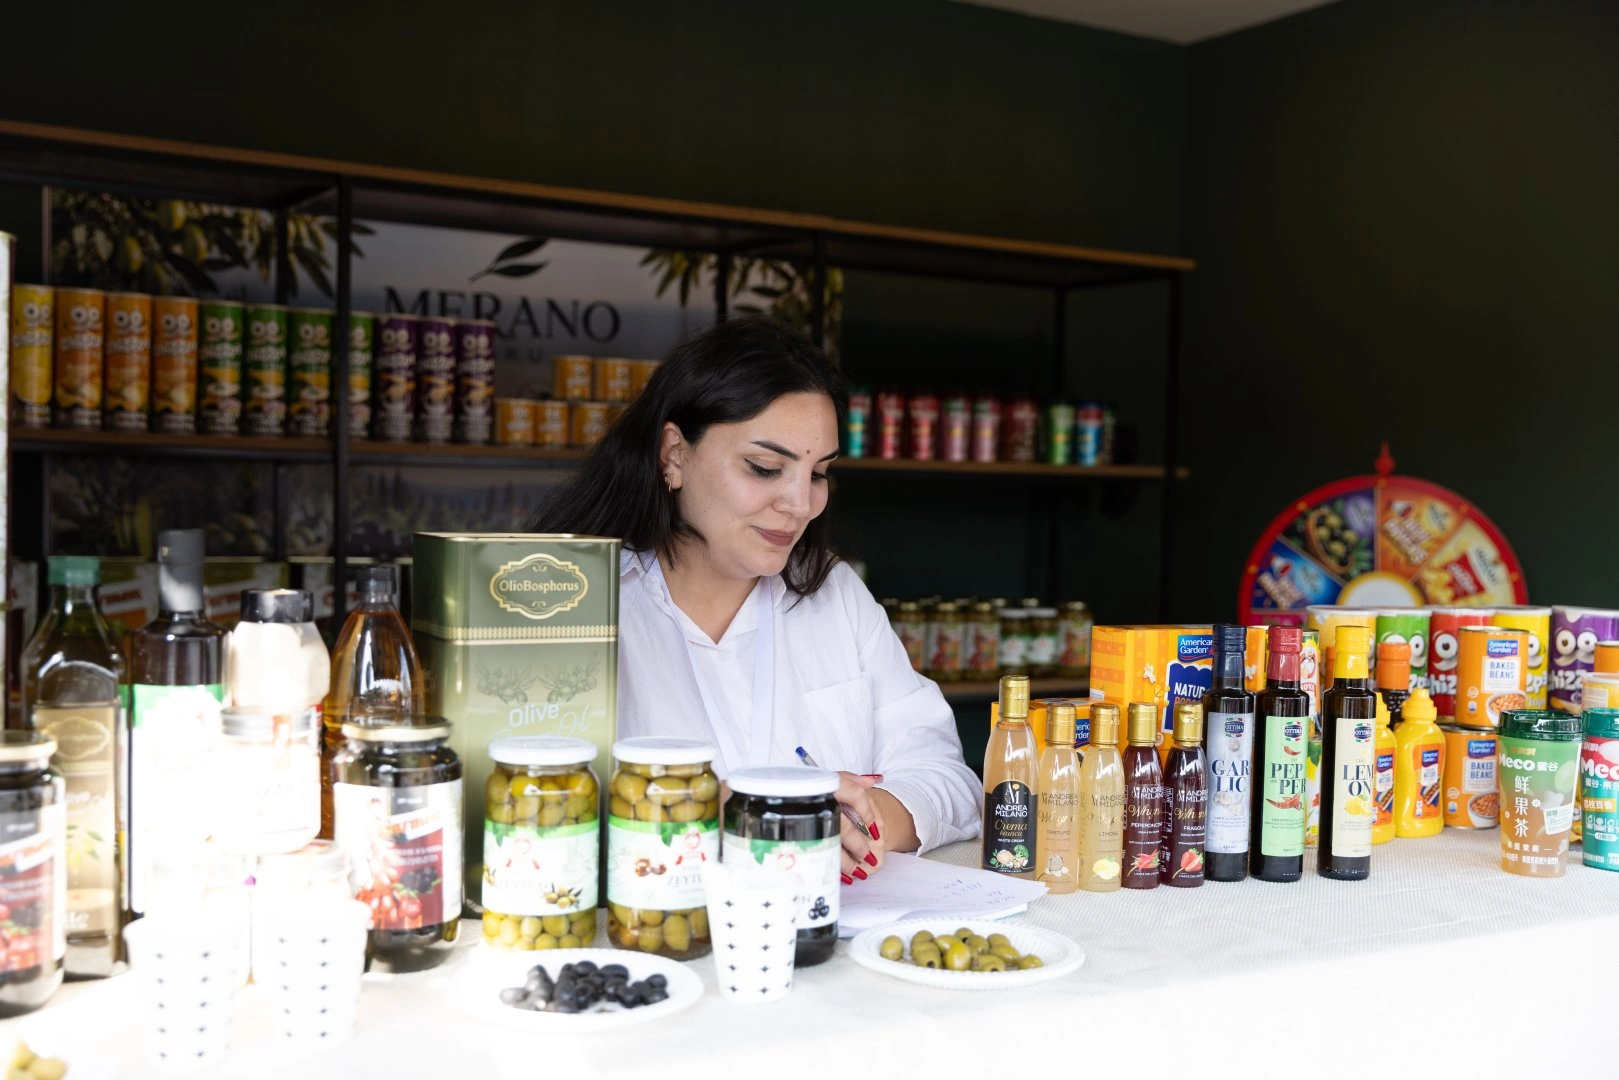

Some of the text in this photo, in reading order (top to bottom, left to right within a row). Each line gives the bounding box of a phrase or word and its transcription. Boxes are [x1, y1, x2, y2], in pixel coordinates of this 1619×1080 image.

[383, 285, 621, 345] MERANO
[499, 580, 581, 597] OlioBosphorus
[1180, 646, 1207, 655] Garden
[1490, 660, 1516, 670] BAKED
[1489, 669, 1515, 679] BEANS
[509, 704, 560, 728] Olive
[1211, 759, 1249, 777] GAR
[1271, 763, 1303, 780] PEP
[1470, 761, 1494, 771] BAKED
[1470, 770, 1493, 780] BEANS
[1216, 776, 1247, 793] LIC
[1279, 779, 1306, 795] PER
[995, 804, 1028, 812] ANDREA
[995, 810, 1028, 818] MILANO
[995, 819, 1028, 831] Crema
